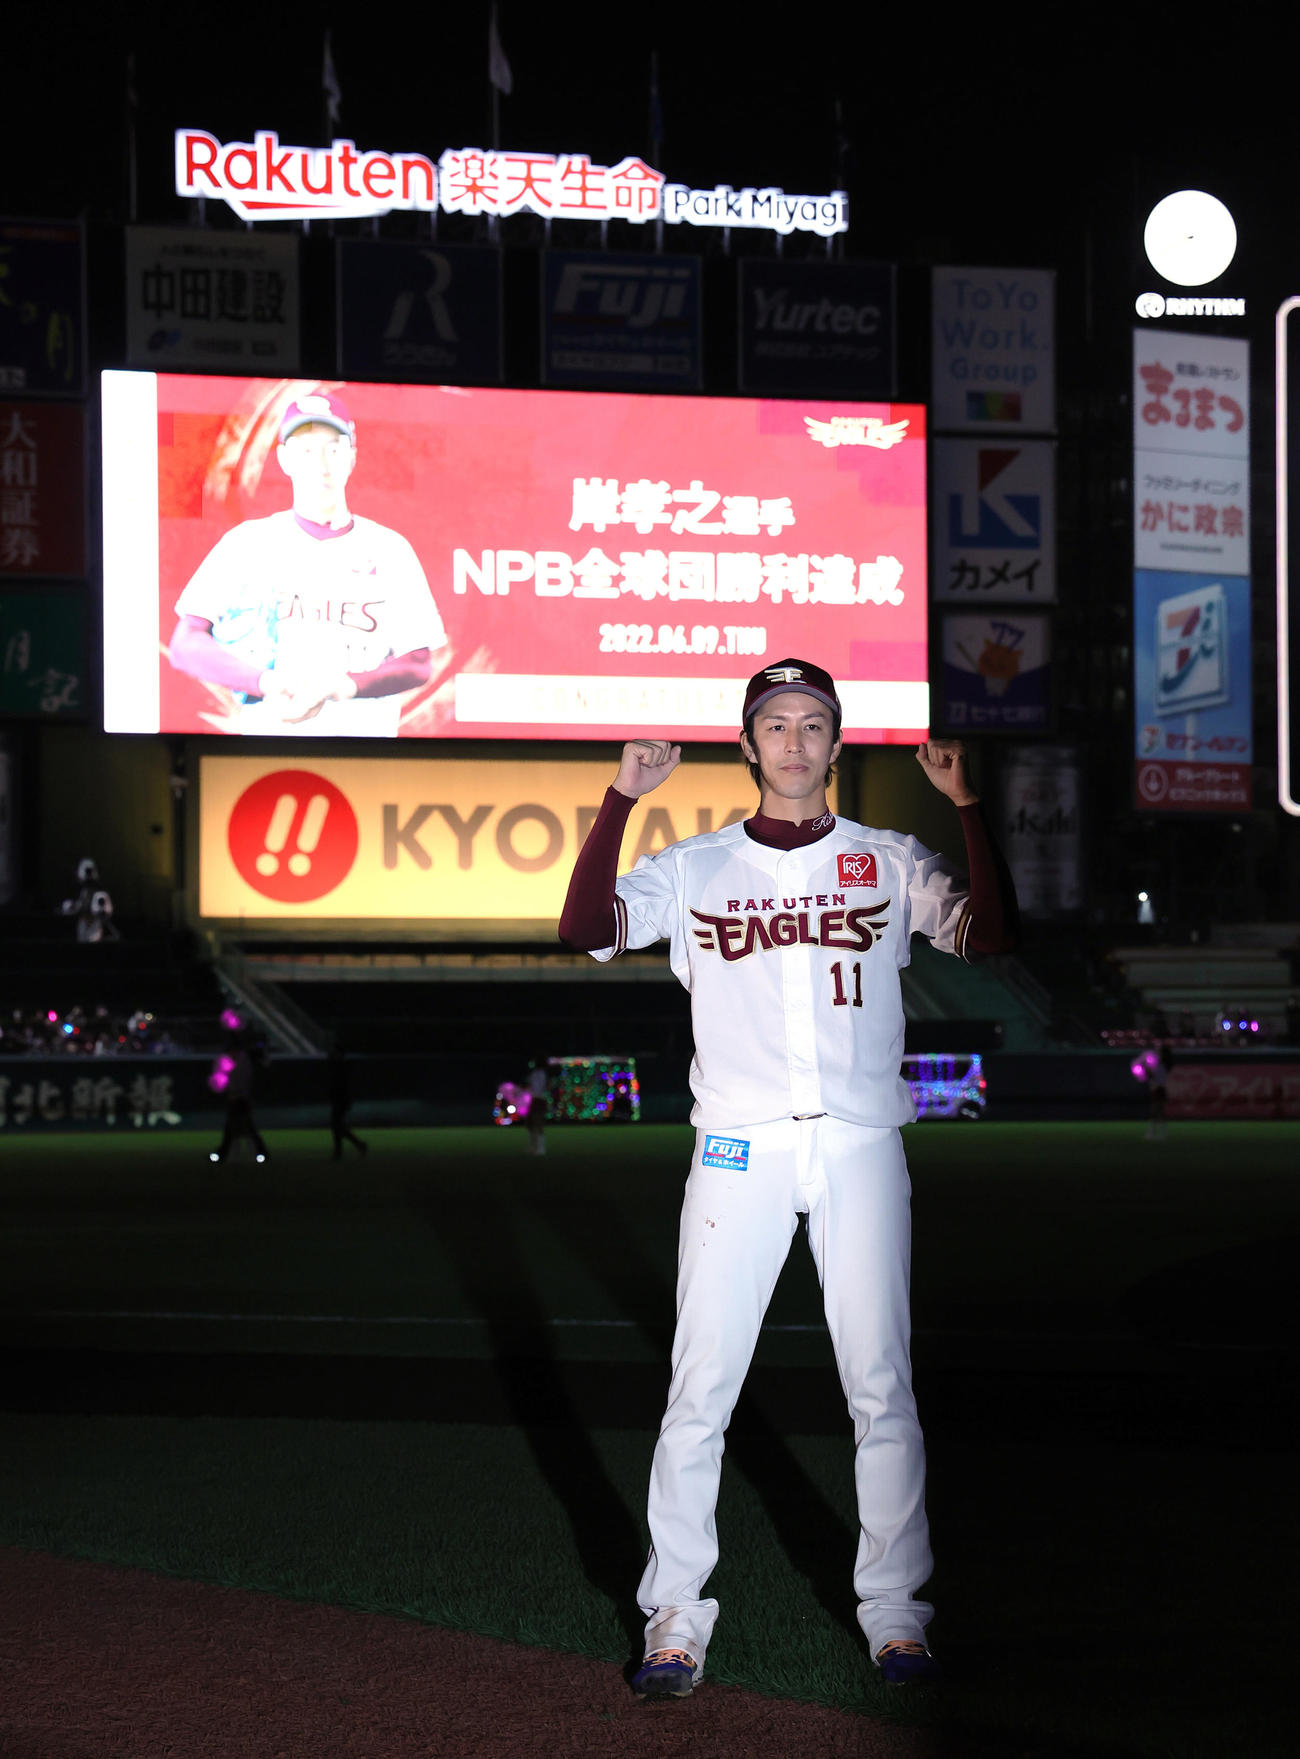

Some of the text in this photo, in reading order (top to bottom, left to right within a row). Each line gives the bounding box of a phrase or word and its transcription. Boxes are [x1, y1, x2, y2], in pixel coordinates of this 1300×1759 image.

[184, 134, 436, 204] Rakuten
[450, 153, 661, 214] 楽天生命
[673, 190, 846, 226] Park Miyagi
[141, 262, 287, 324] 中田建設
[553, 263, 692, 328] Fuji
[752, 286, 881, 335] Yurtec
[951, 279, 1040, 313] ToYo
[950, 357, 1038, 386] Group
[1138, 361, 1245, 434] まるまつ
[0, 410, 39, 568] 大和証券
[948, 558, 1041, 592] カメイ
[842, 861, 864, 875] IRIS
[726, 893, 847, 913] RAKUTEN
[692, 897, 889, 962] EAGLES
[830, 961, 864, 1008] 11
[707, 1138, 746, 1159] Fuji
